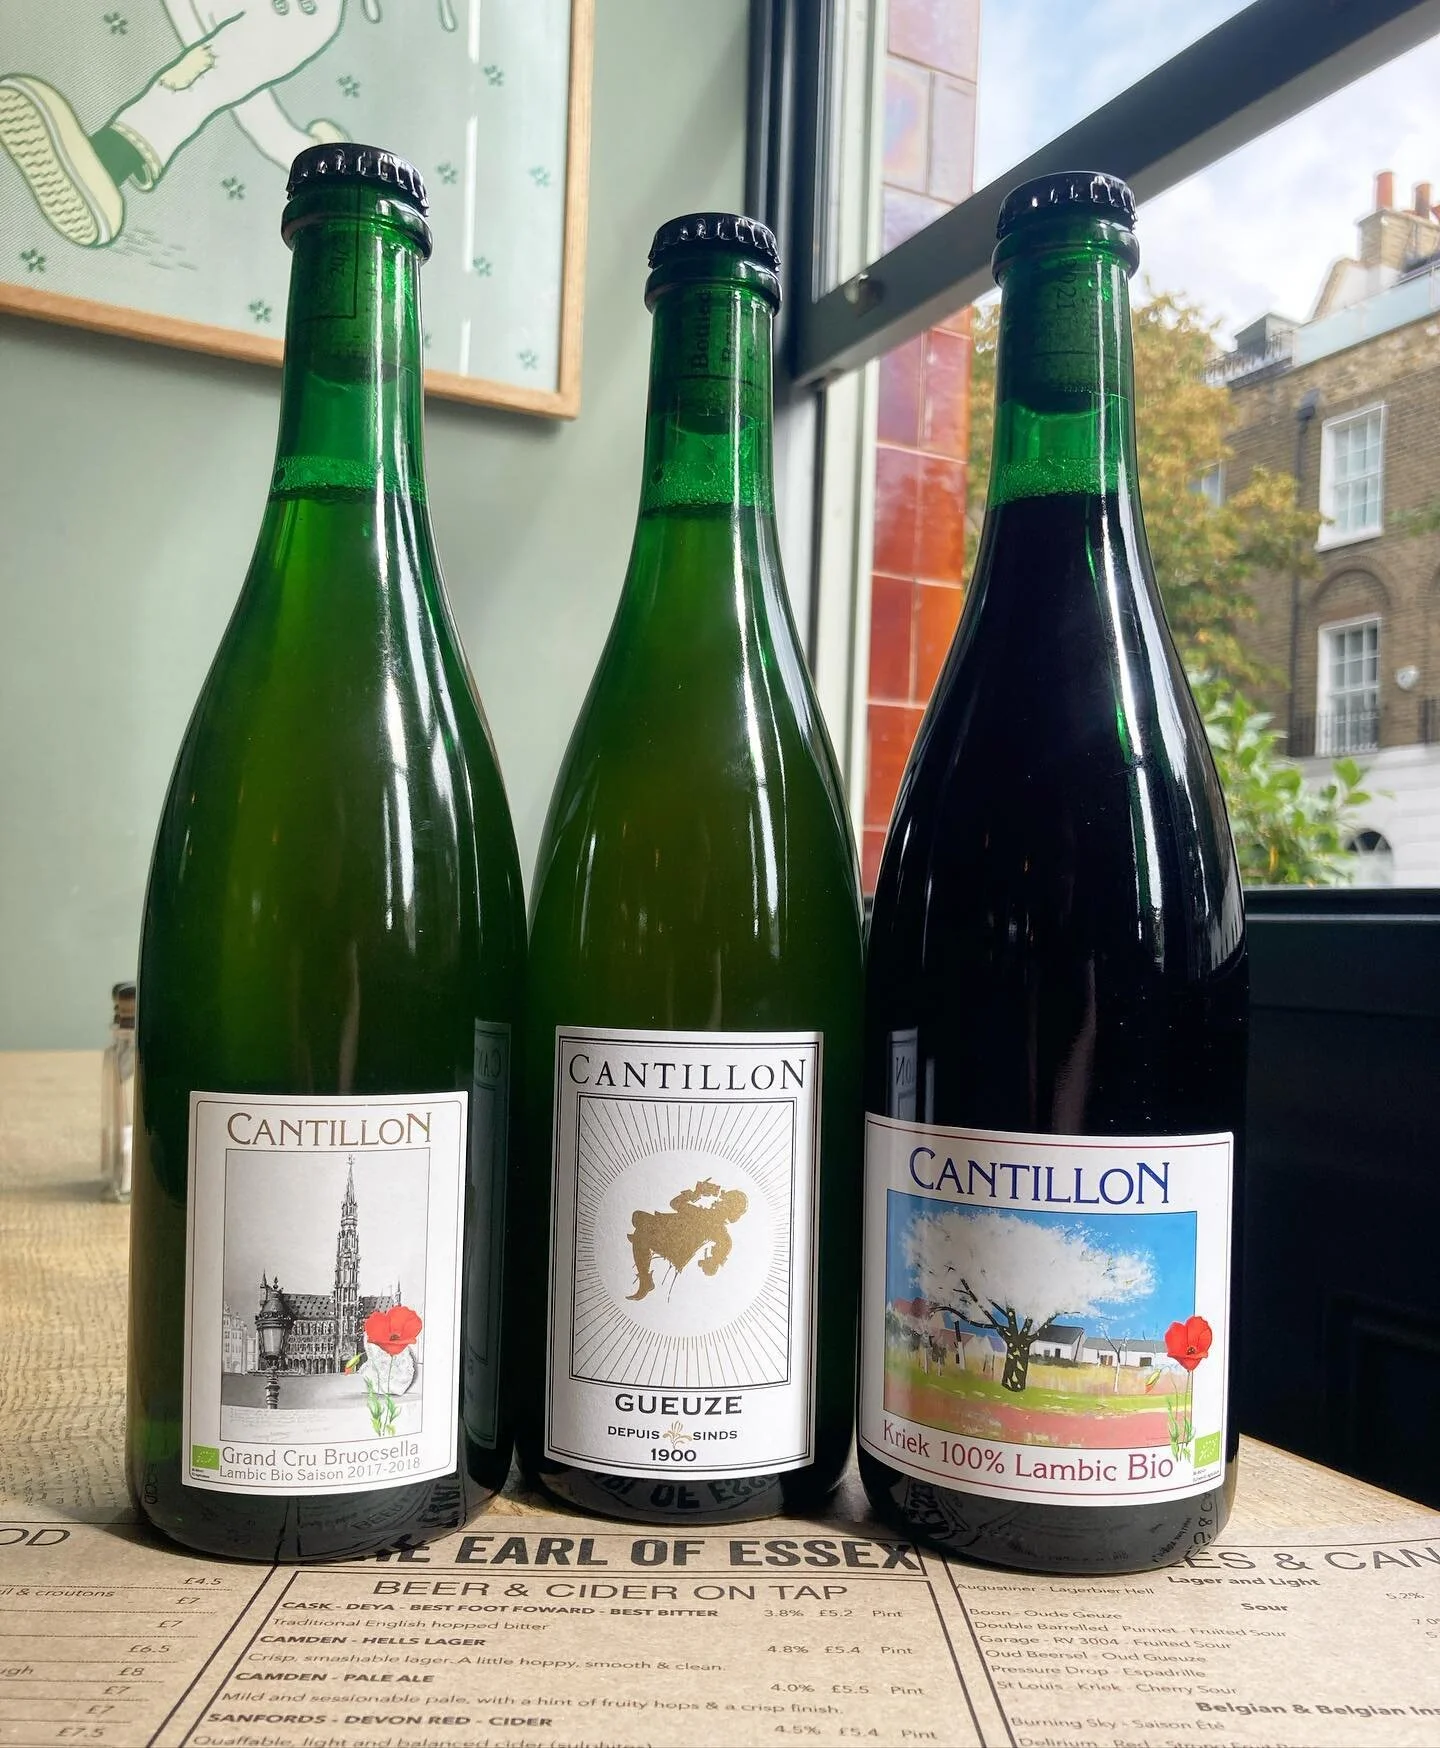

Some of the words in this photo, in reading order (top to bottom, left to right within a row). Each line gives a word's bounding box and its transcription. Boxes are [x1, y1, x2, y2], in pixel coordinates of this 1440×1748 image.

[569, 1054, 807, 1091] CANTILLON
[226, 1112, 432, 1147] CANTILLON
[909, 1146, 1170, 1204] CANTILLON
[615, 1392, 743, 1415] GUEUZE
[607, 1425, 661, 1440] DEPUIS
[693, 1429, 738, 1441] SINDS
[222, 1447, 276, 1467] Grand
[283, 1450, 317, 1467] Cru
[324, 1440, 419, 1466] Bruocsella
[650, 1447, 698, 1462] 1900
[883, 1419, 930, 1458] Kriek
[941, 1440, 1005, 1474] 100%
[1016, 1453, 1117, 1483] Lambic
[1128, 1453, 1174, 1481] Bio
[219, 1465, 267, 1481] Lambic
[270, 1469, 293, 1482] Bio
[297, 1467, 344, 1481] Saison
[347, 1457, 421, 1479] 2017-2018
[454, 1536, 608, 1566] EARL
[629, 1538, 706, 1567] OF
[729, 1539, 922, 1571] ESSEX
[1273, 1552, 1315, 1570] &
[183, 1577, 223, 1586] £4.5
[956, 1583, 1036, 1592] Augustiner
[1050, 1586, 1120, 1594] Lagerbier
[1124, 1587, 1155, 1595] Hell
[1167, 1576, 1223, 1586] Lager
[1228, 1577, 1267, 1586] and
[1268, 1577, 1321, 1588] Light
[16, 1588, 31, 1597] &
[35, 1590, 116, 1598] croutons
[373, 1580, 490, 1597] BEER
[503, 1583, 530, 1598] &
[545, 1583, 677, 1600] CIDER
[693, 1584, 756, 1601] ON
[768, 1584, 848, 1601] TAP
[176, 1596, 201, 1605] £7
[1241, 1602, 1289, 1612] Sour
[282, 1601, 333, 1610] CASK
[346, 1603, 395, 1611] DEYA
[512, 1605, 596, 1614] FOWARD
[610, 1608, 655, 1616] BEST
[657, 1609, 719, 1617] BITTER
[764, 1609, 805, 1617] 3.8%
[819, 1609, 854, 1617] £5.2
[872, 1609, 904, 1618] Pint
[969, 1608, 1012, 1616] Boon
[1024, 1609, 1069, 1618] Oude
[1072, 1611, 1123, 1620] Geuze
[157, 1620, 183, 1628] £7
[273, 1617, 361, 1627] Traditional
[365, 1619, 426, 1630] English
[432, 1620, 499, 1630] hopped
[504, 1621, 551, 1631] bitter
[974, 1621, 1033, 1630] Double
[1037, 1623, 1109, 1632] Barrelled
[1249, 1629, 1287, 1638] Sour
[128, 1644, 173, 1653] £6.5
[259, 1635, 349, 1644] CAMDEN
[362, 1637, 420, 1645] HELLS
[424, 1638, 487, 1646] LAGER
[767, 1645, 810, 1654] 4.8%
[824, 1646, 862, 1655] £5.4
[881, 1646, 914, 1655] Pint
[979, 1635, 1040, 1645] Garage
[1053, 1636, 1074, 1645] RV
[1080, 1637, 1120, 1647] 3004
[1193, 1640, 1232, 1650] Sour
[248, 1652, 297, 1663] Crisp,
[303, 1654, 400, 1663] smashable
[456, 1656, 472, 1664] A
[476, 1656, 514, 1666] little
[585, 1660, 651, 1669] smooth
[656, 1661, 671, 1670] &
[675, 1662, 726, 1671] clean.
[985, 1649, 1022, 1658] Oud
[1026, 1650, 1088, 1659] Beersel
[1102, 1652, 1139, 1661] Oud
[1143, 1653, 1207, 1663] Gueuze
[116, 1667, 145, 1677] £8
[991, 1665, 1061, 1674] Pressure
[1065, 1666, 1109, 1676] Drop
[1122, 1667, 1206, 1678] Espadrille
[103, 1685, 131, 1695] £7
[235, 1672, 328, 1681] CAMDEN
[343, 1673, 394, 1682] PALE
[396, 1674, 435, 1683] ALE
[770, 1683, 816, 1693] 4.0%
[831, 1684, 870, 1694] £5.5
[890, 1685, 925, 1696] Pint
[1018, 1681, 1063, 1690] Louis
[1136, 1683, 1193, 1695] Cherry
[86, 1704, 115, 1715] £7
[222, 1692, 265, 1701] Mild
[269, 1693, 306, 1702] and
[310, 1694, 421, 1703] sessionable
[477, 1695, 515, 1705] with
[538, 1696, 572, 1706] hint
[578, 1697, 597, 1707] of
[601, 1697, 648, 1710] fruity
[653, 1700, 700, 1711] hops
[705, 1701, 719, 1711] &
[740, 1703, 785, 1713] crisp
[1195, 1702, 1287, 1716] Belgian
[1291, 1704, 1315, 1715] &
[1315, 1704, 1407, 1718] Belgian
[56, 1726, 107, 1738] £7.5
[207, 1713, 328, 1724] SANFORDS
[344, 1715, 423, 1725] DEVON
[427, 1716, 471, 1725] RED
[488, 1717, 553, 1727] CIDER
[773, 1725, 822, 1736] 4.5%
[839, 1726, 880, 1737] £5.4
[901, 1728, 939, 1740] Pint
